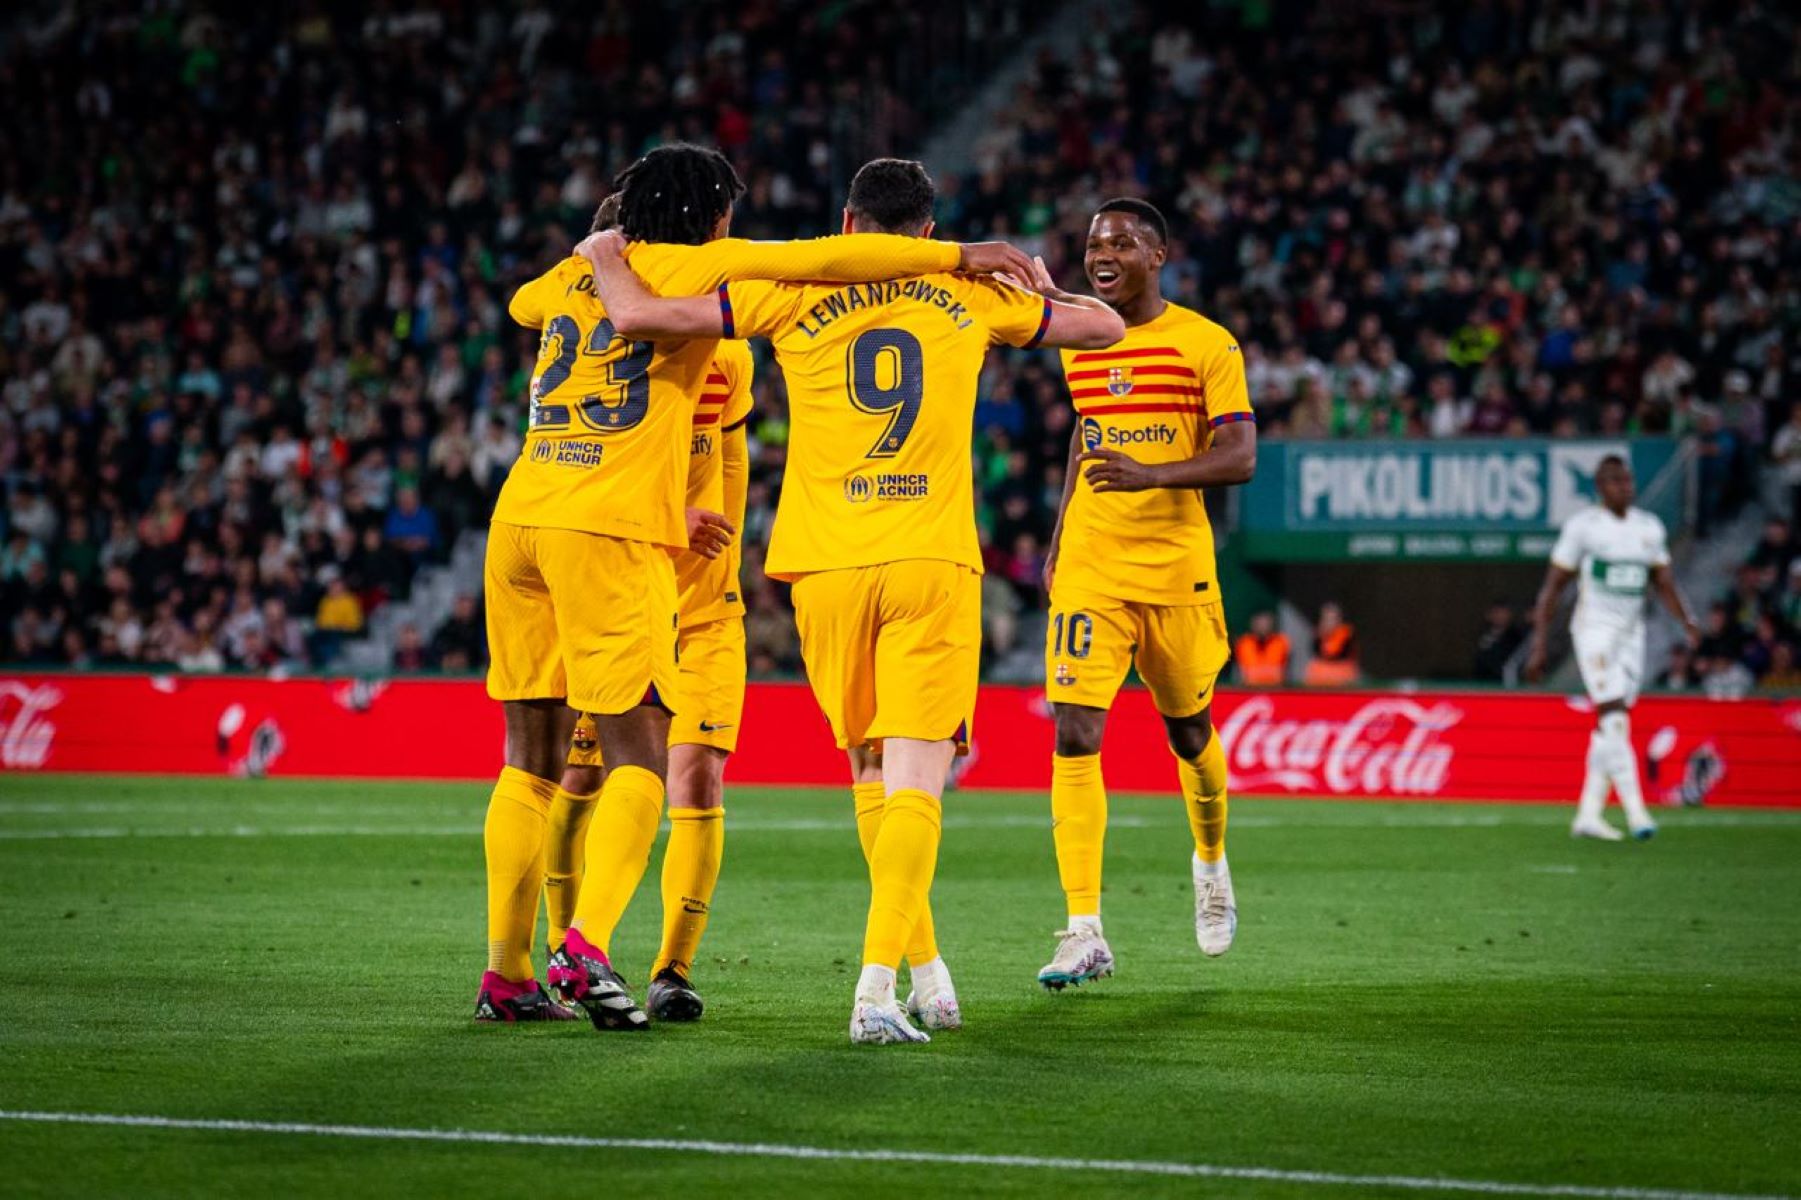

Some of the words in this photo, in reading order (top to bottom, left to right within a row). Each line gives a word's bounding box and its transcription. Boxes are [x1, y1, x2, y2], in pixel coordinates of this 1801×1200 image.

[796, 279, 974, 338] LEWANDOWSKI
[530, 315, 654, 434] 23
[847, 328, 924, 458] 9
[556, 451, 601, 465] ACNUR
[559, 440, 603, 455] UNHCR
[1107, 425, 1177, 445] Spotify
[877, 474, 928, 485] UNHCR
[877, 485, 928, 496] ACNUR
[1300, 454, 1543, 521] PIKOLINOS
[1054, 612, 1093, 659] 10
[1219, 695, 1466, 794] Coca-Cola
